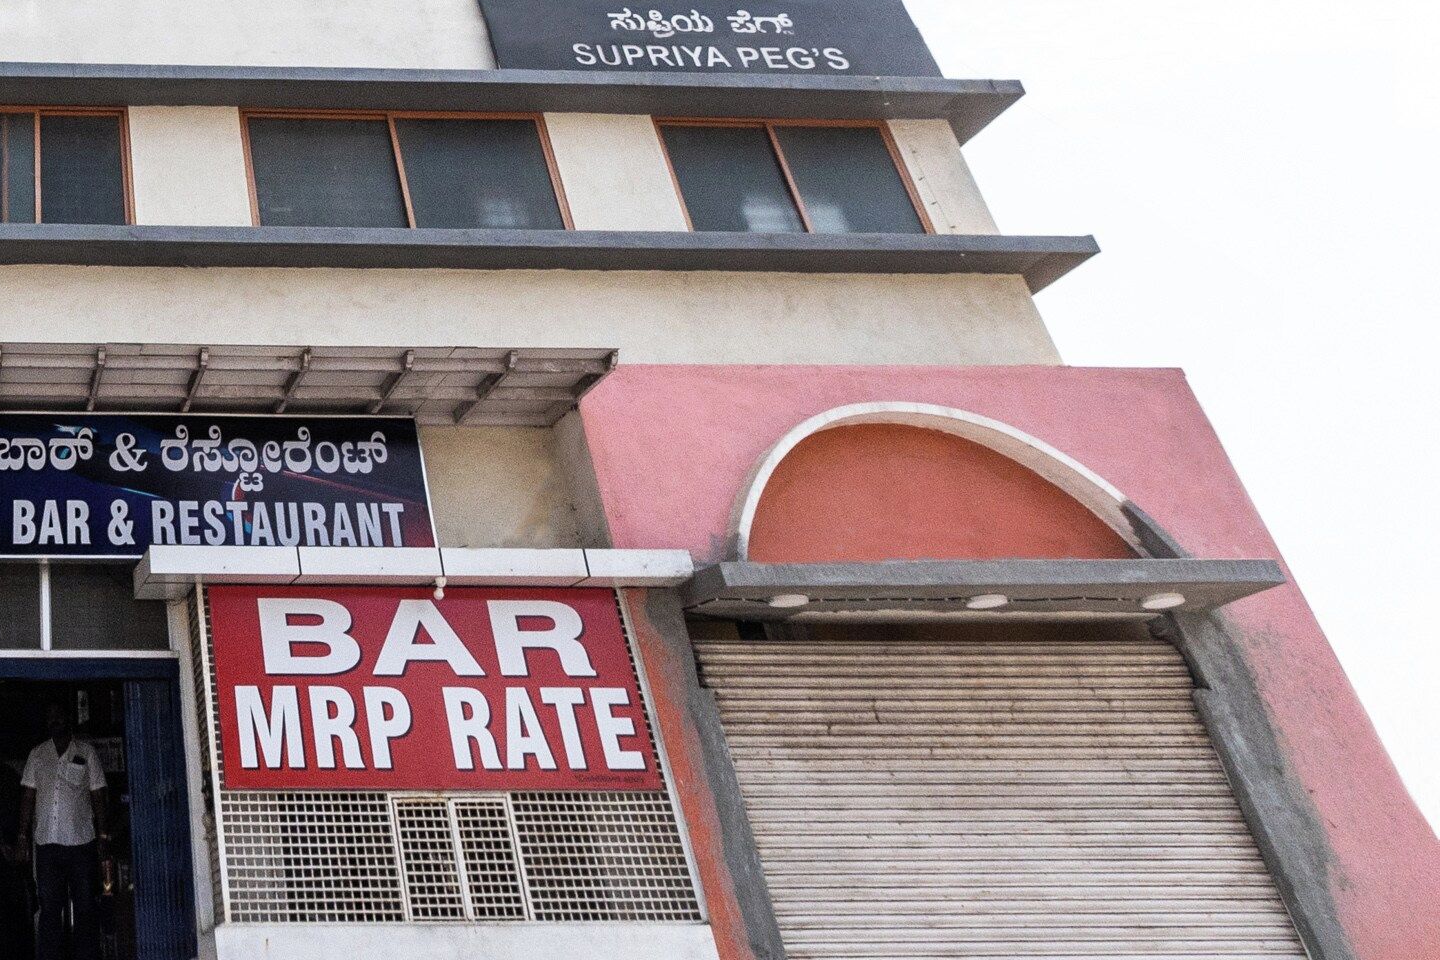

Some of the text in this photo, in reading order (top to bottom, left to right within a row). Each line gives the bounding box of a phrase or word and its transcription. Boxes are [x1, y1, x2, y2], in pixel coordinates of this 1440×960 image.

[607, 7, 714, 38] ಸುಪ್ರಿಯ
[572, 42, 850, 70] SUPRIYA PEG'S
[108, 432, 148, 472] &
[160, 424, 389, 492] ರೆಸ್ಟೋರೆಂಟ್
[12, 499, 92, 546] BAR
[108, 499, 136, 546] &
[150, 500, 405, 548] RESTAURANT
[257, 597, 598, 678] BAR
[234, 684, 647, 771] MRP RATE
